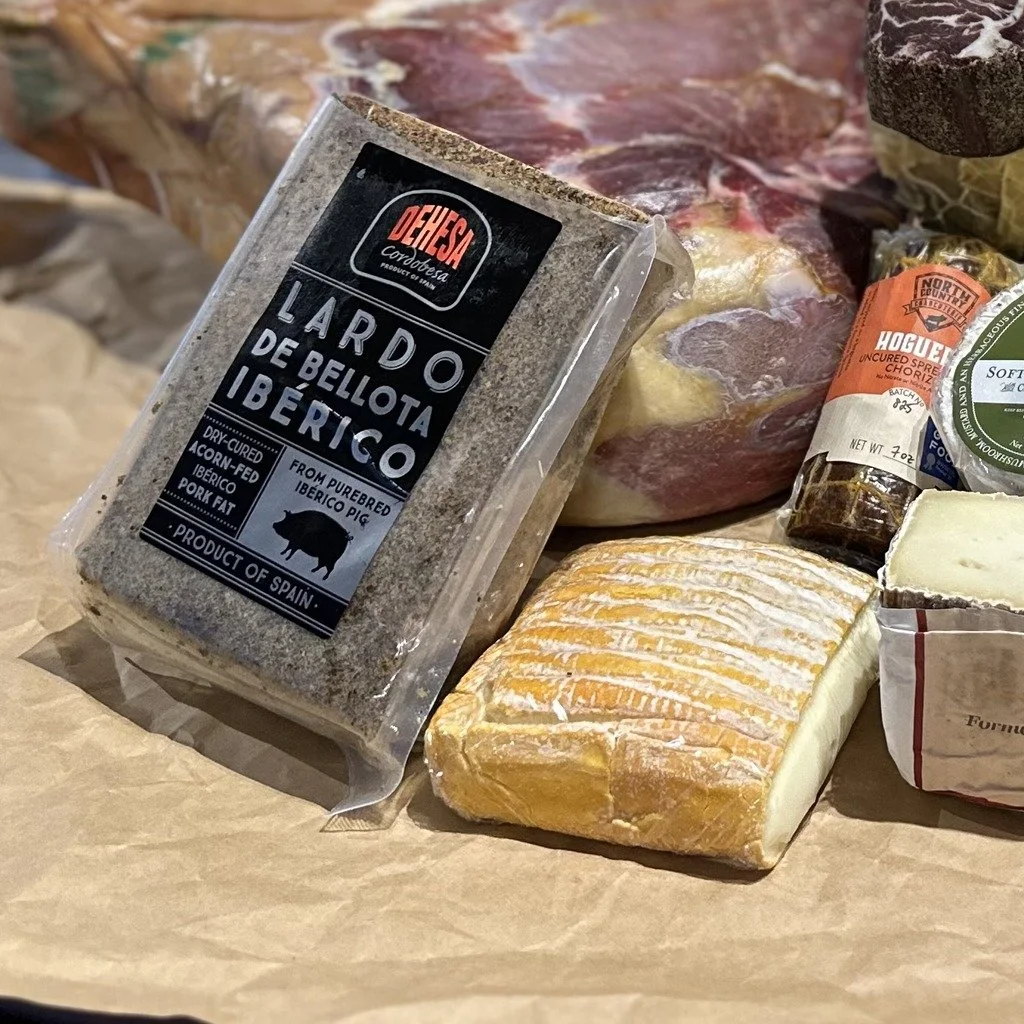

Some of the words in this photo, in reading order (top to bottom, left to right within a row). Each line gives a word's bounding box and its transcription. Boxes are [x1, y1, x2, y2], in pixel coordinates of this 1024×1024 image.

[387, 204, 475, 270] DEHESA
[380, 262, 410, 276] PRODUCT
[410, 273, 420, 281] OF
[419, 278, 436, 290] SPAIN
[381, 246, 449, 282] Cordobesa
[920, 288, 967, 309] COUNTRY
[922, 277, 972, 302] NORTH
[277, 280, 465, 393] LARDO
[859, 352, 909, 364] UNCURED
[960, 368, 969, 382] AN
[251, 328, 299, 368] DE
[297, 350, 433, 438] BELLOTA
[889, 388, 915, 399] BATCH
[959, 385, 968, 405] AND
[226, 365, 416, 479] IBÉRICO
[202, 425, 264, 465] DRY-CURED
[850, 438, 867, 451] NET
[869, 442, 884, 454] WT
[1009, 439, 1022, 449] Net
[188, 440, 260, 485] ACORN-FED
[192, 463, 237, 495] IBÉRICO
[177, 477, 216, 505] PORK
[212, 494, 236, 516] FAT
[288, 459, 327, 486] FROM
[326, 477, 392, 517] PUREBRED
[295, 480, 345, 513] IBÉRICO
[346, 506, 369, 527] PIG
[174, 523, 244, 571] PRODUCT
[244, 563, 270, 584] OF
[269, 576, 314, 610] SPAIN
